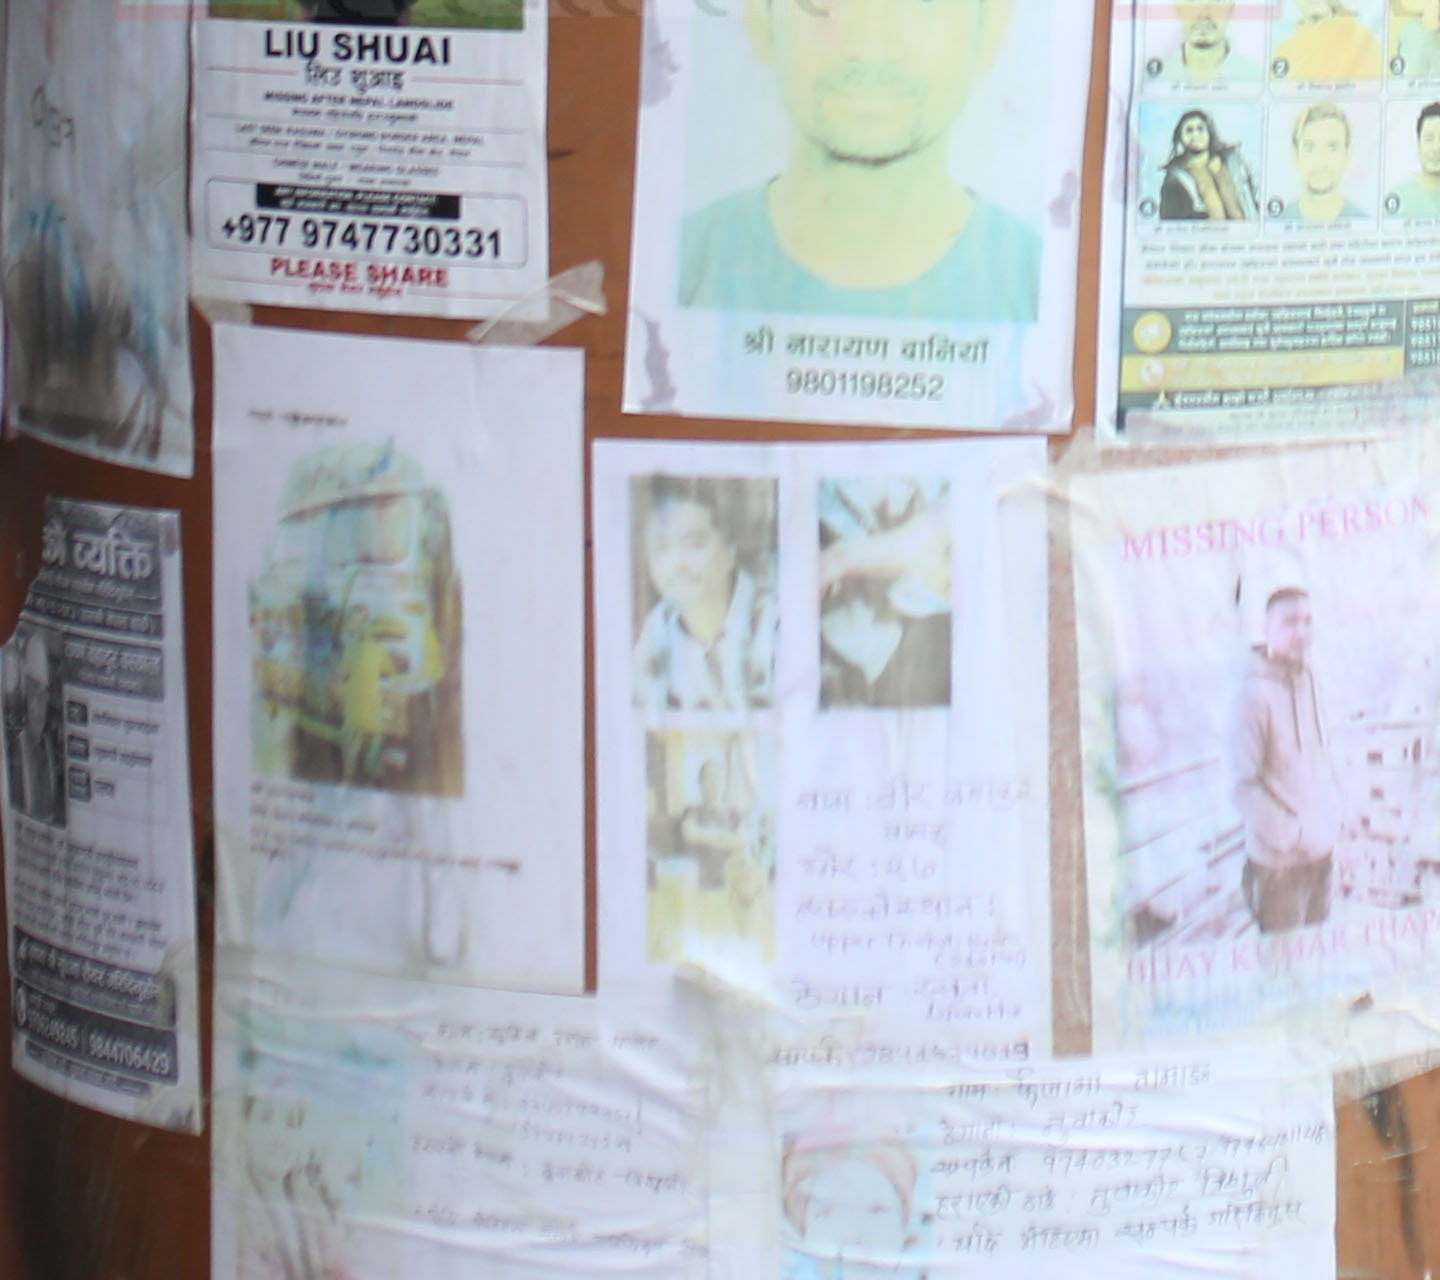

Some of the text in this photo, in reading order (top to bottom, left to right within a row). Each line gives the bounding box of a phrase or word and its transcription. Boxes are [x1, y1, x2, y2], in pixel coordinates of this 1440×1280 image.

[265, 29, 451, 65] LIU SHUAI
[223, 214, 501, 258] +977 9747730331
[270, 257, 448, 287] PLEASE SHARE
[786, 368, 945, 400] 9801198252
[1123, 494, 1429, 562] MISSING PERSON
